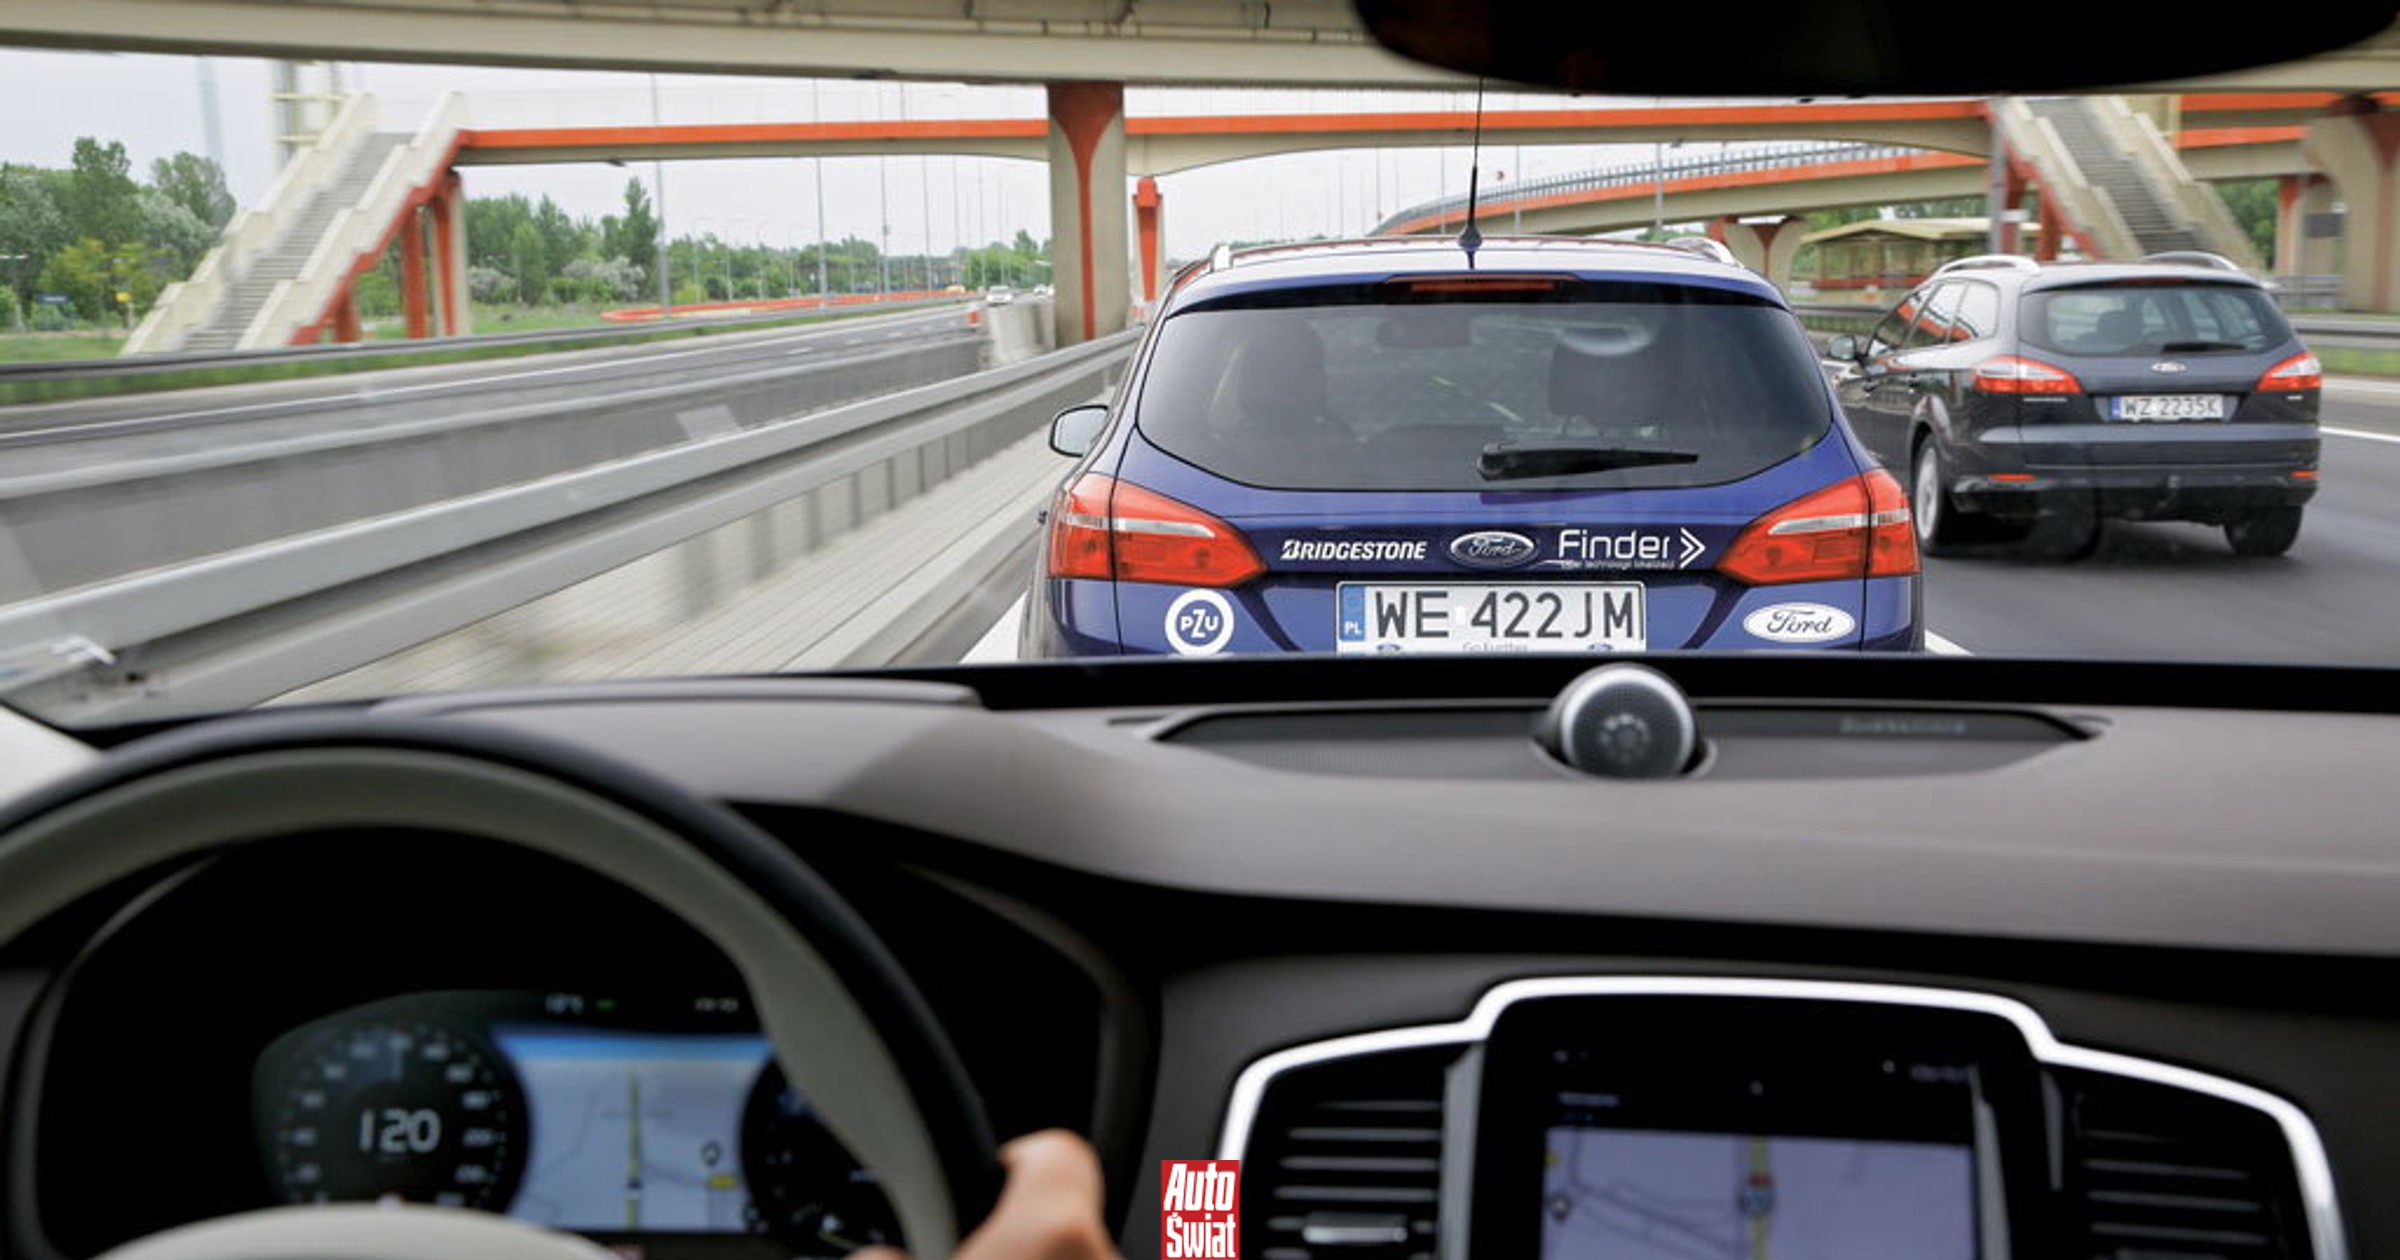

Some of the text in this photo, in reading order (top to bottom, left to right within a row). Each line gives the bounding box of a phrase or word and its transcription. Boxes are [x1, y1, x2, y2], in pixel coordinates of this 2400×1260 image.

[1281, 539, 1428, 560] BRIDGESTONE
[1558, 529, 1670, 559] Finder
[1181, 609, 1219, 638] PZU
[1345, 621, 1362, 635] PL
[1375, 591, 1633, 638] WE 422JM
[1767, 610, 1832, 633] Ford
[360, 1108, 441, 1152] 120
